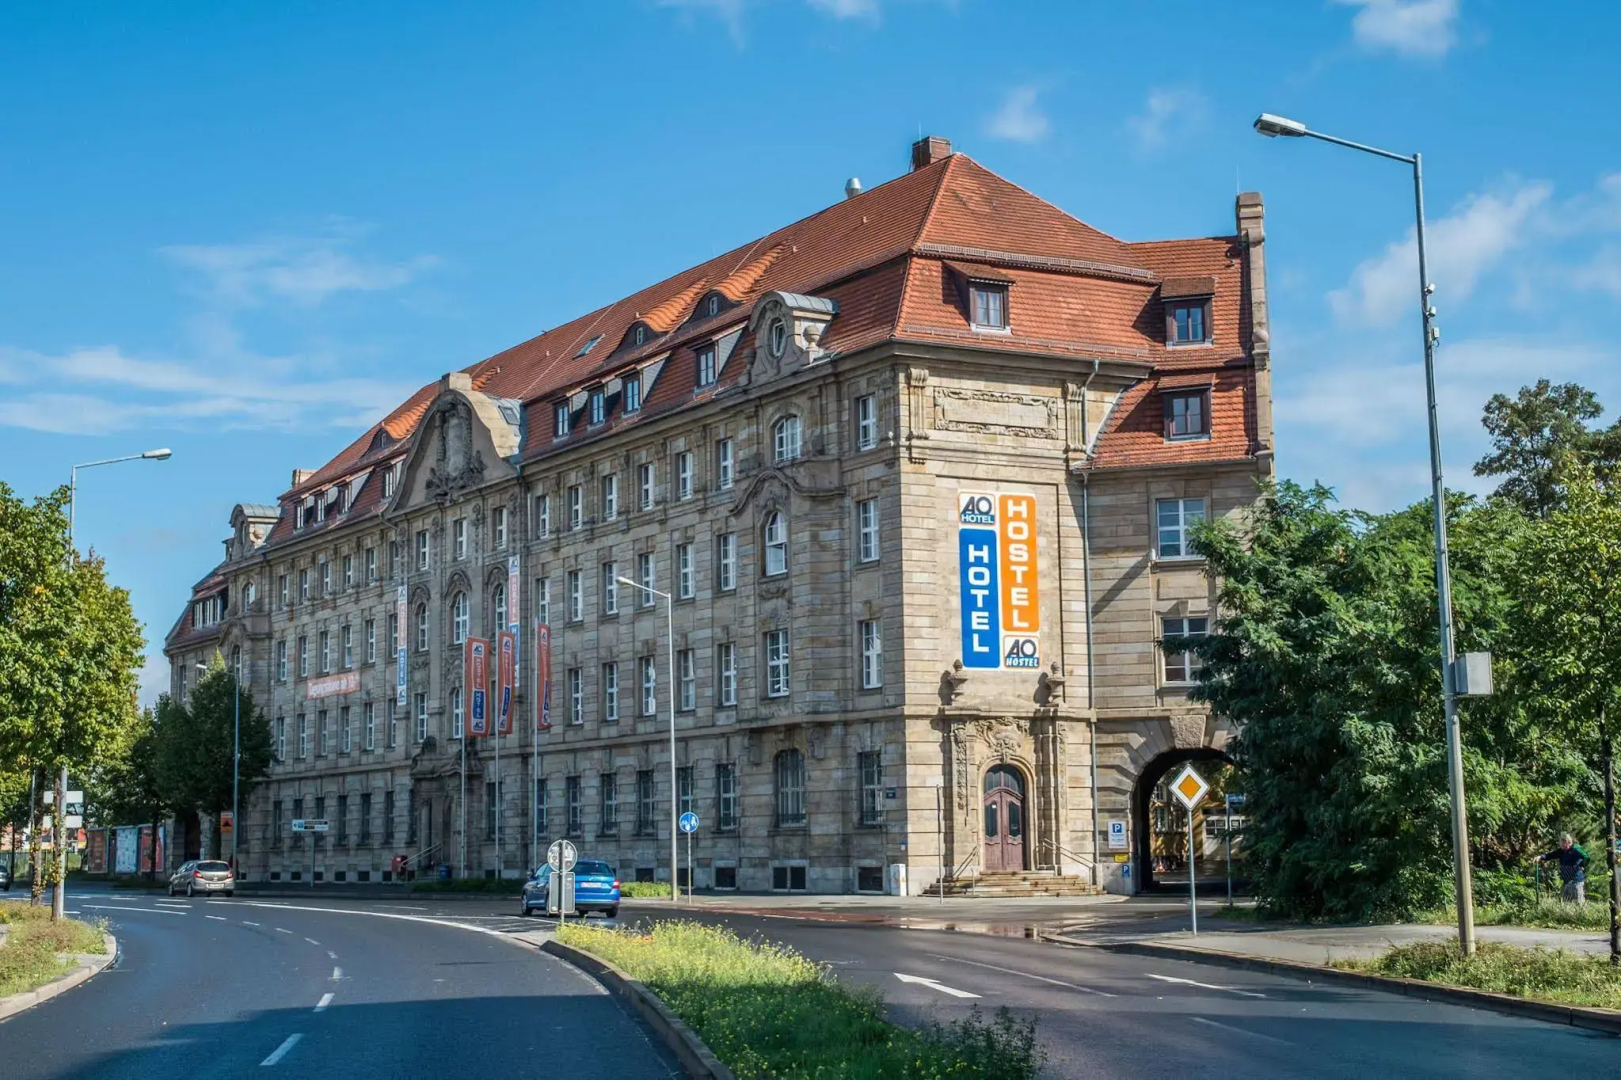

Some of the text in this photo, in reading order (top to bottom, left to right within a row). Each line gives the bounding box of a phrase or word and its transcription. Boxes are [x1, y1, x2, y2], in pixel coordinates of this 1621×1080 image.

[961, 514, 994, 524] HOTEL
[1007, 499, 1030, 628] HOSTEL
[968, 544, 990, 652] HOTEL
[1006, 657, 1039, 667] HOSTEL
